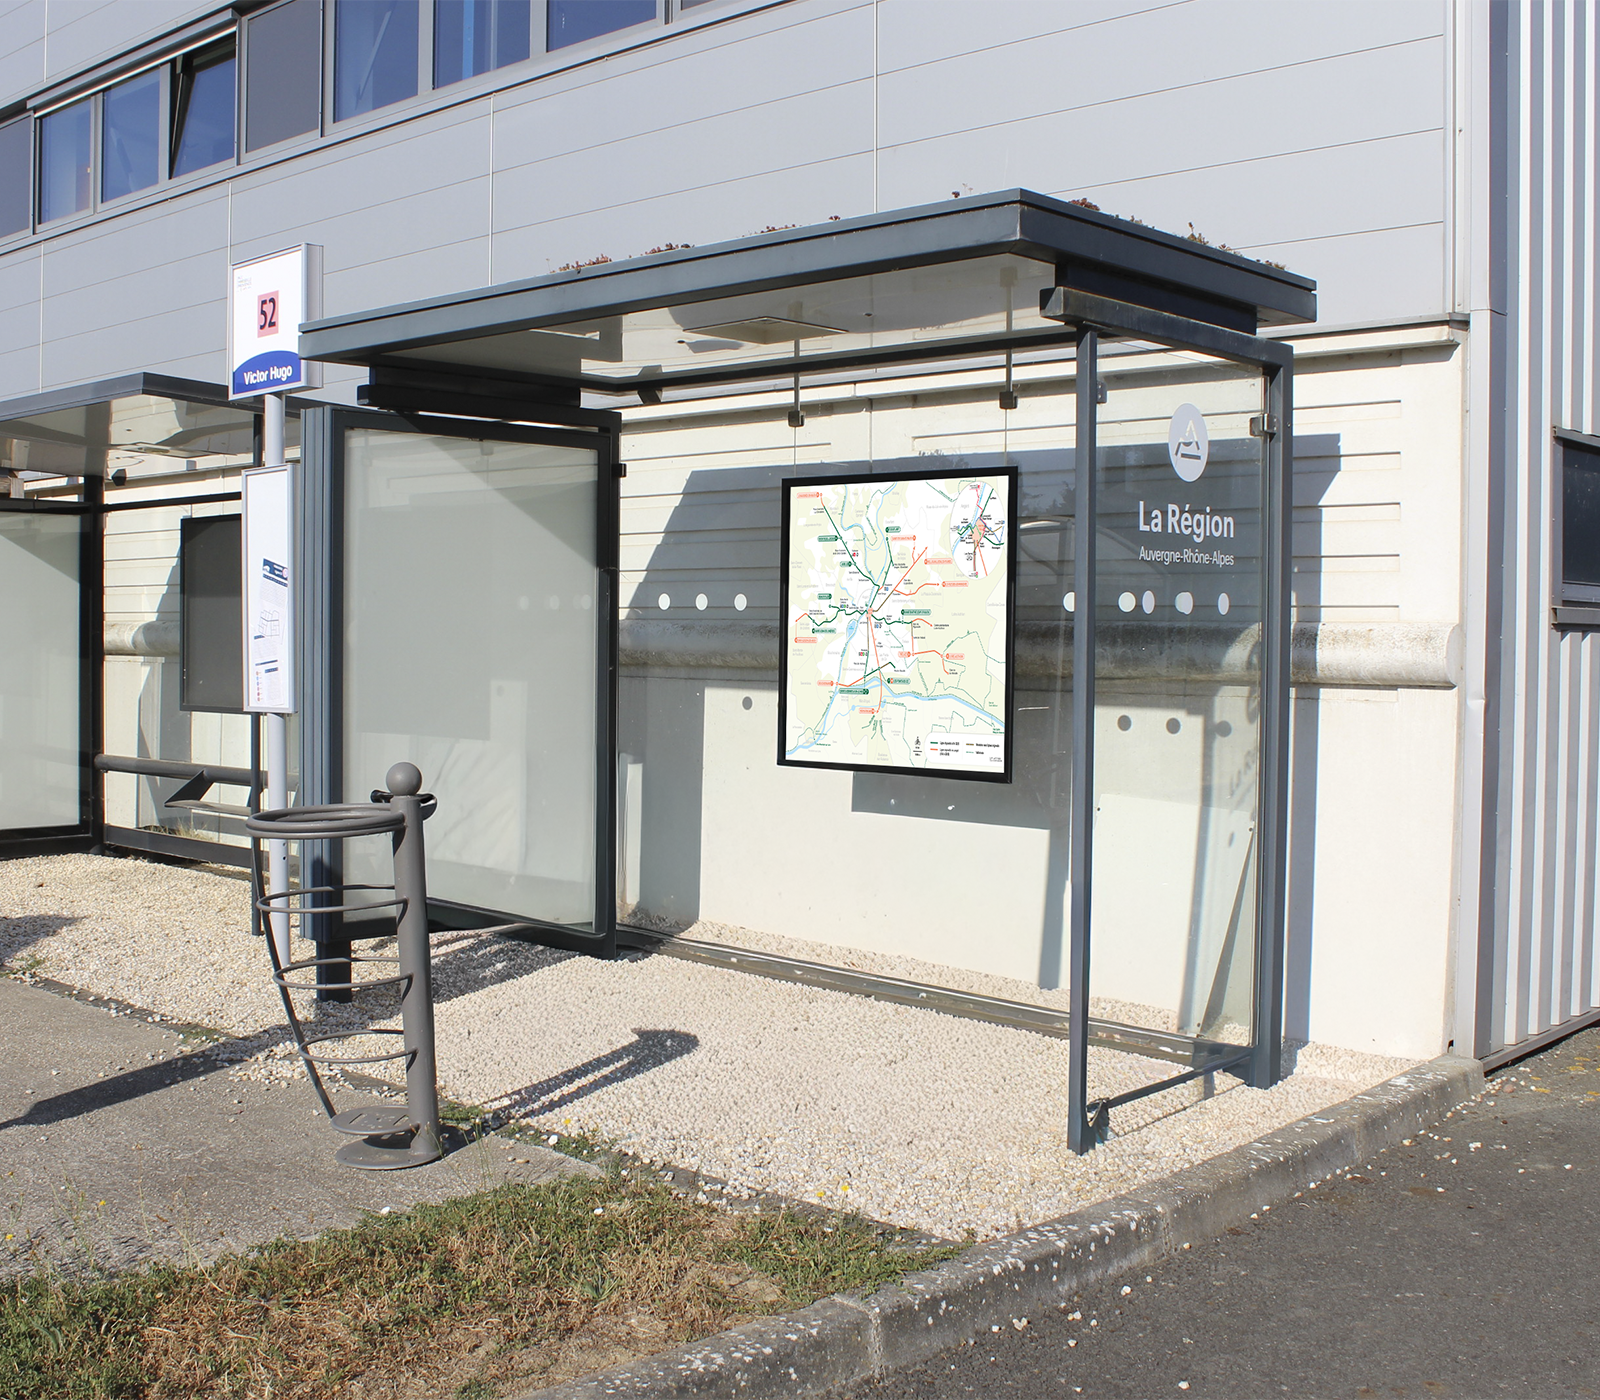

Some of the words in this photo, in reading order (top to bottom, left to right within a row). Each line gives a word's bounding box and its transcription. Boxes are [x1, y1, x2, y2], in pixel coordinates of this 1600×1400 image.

[259, 297, 276, 330] 52
[243, 372, 269, 386] Victor
[270, 364, 293, 381] Hugo
[1139, 500, 1162, 533] La
[1167, 503, 1235, 543] Région
[1139, 546, 1235, 568] Auvergne-Rhône-Alpes
